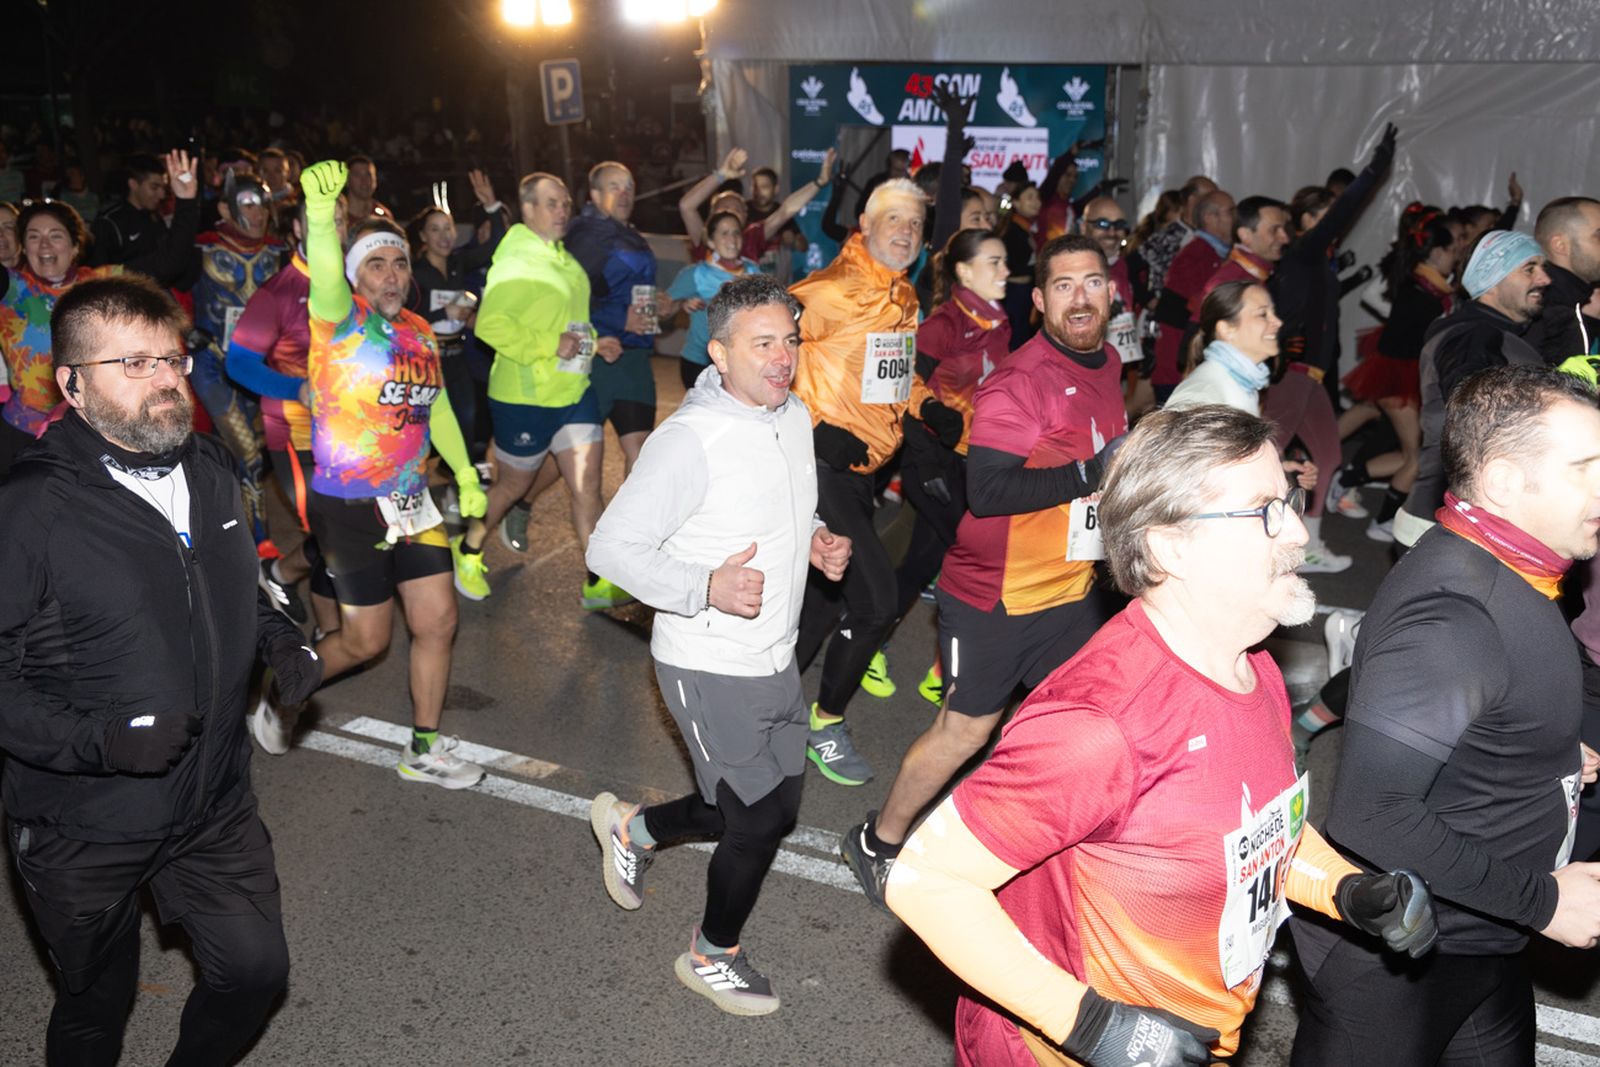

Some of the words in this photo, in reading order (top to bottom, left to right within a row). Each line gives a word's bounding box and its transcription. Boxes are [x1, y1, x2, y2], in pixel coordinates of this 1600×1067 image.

[550, 68, 574, 117] P
[904, 73, 934, 99] 43
[969, 152, 1006, 170] SAN
[877, 357, 910, 380] 6094
[379, 381, 407, 406] SE
[1250, 823, 1275, 855] NOCHE
[1274, 814, 1285, 833] DE
[1240, 856, 1259, 885] SAN
[1126, 1013, 1152, 1062] ANTÓN
[1144, 1020, 1161, 1050] SAN
